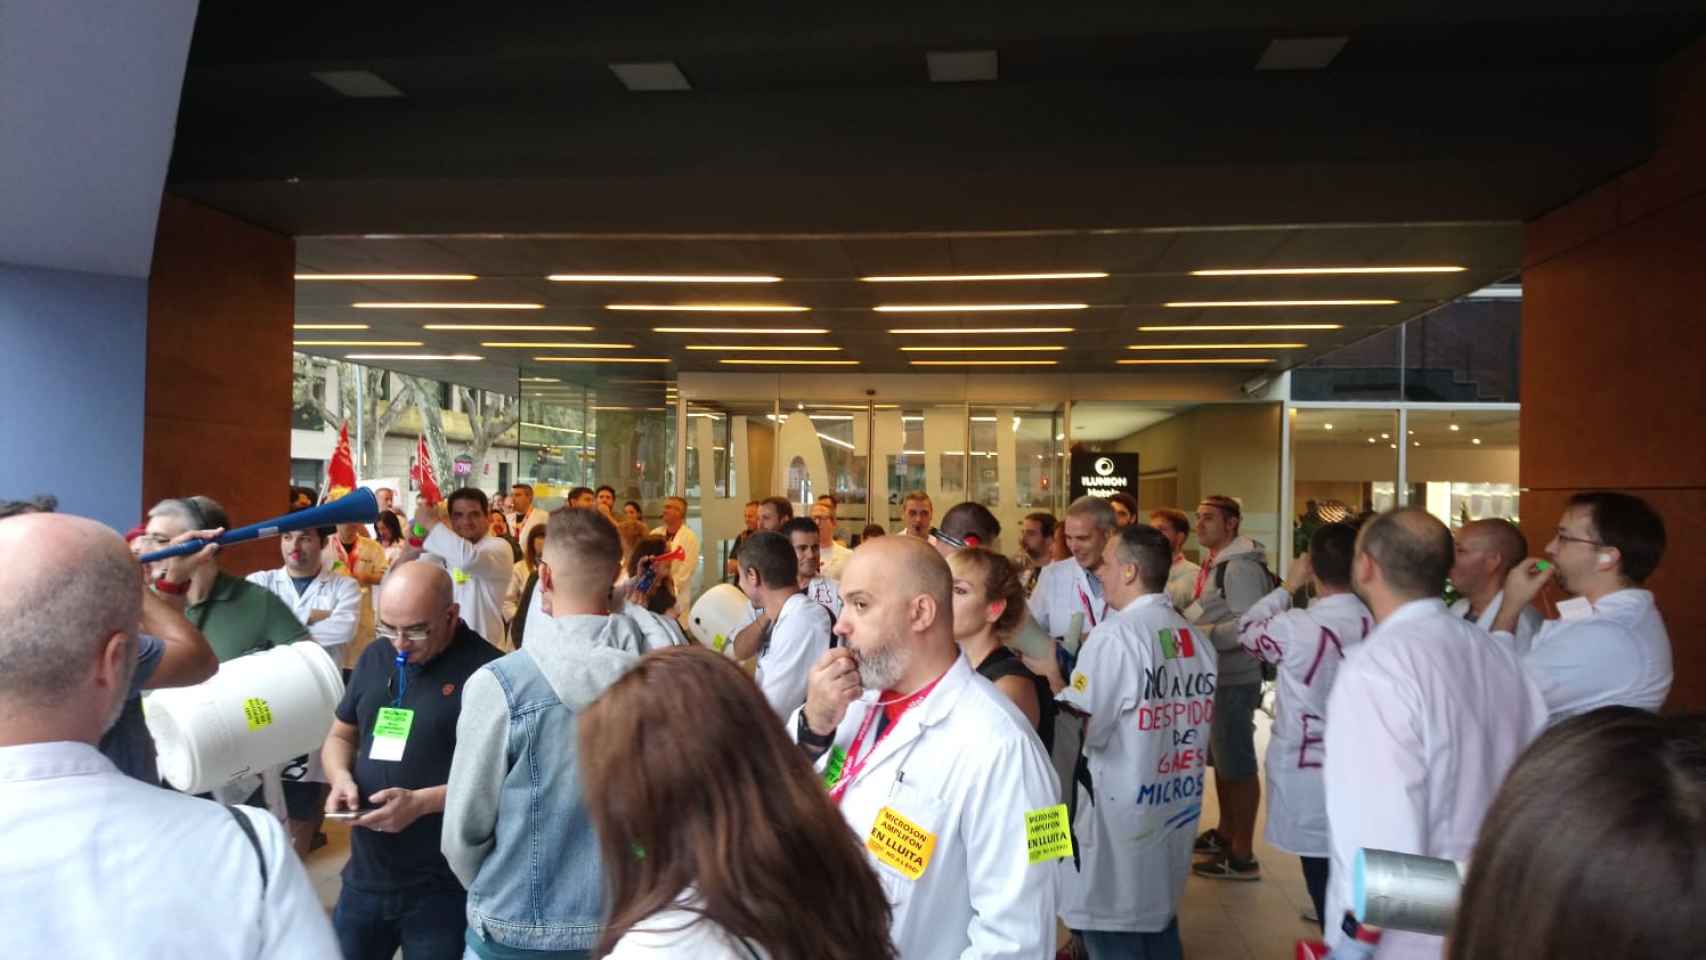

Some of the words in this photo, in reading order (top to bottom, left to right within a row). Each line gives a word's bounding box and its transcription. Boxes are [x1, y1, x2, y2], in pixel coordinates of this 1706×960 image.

[1081, 476, 1127, 487] ILUNION
[1144, 665, 1168, 700] NO
[1185, 672, 1216, 698] LOS
[1172, 729, 1198, 746] DE
[1158, 749, 1205, 774] GAES
[880, 821, 923, 851] AMPLIFON
[885, 811, 928, 843] MICROSON
[1039, 831, 1068, 847] LLUITA
[870, 826, 886, 842] EN
[885, 837, 924, 867] LLUITA
